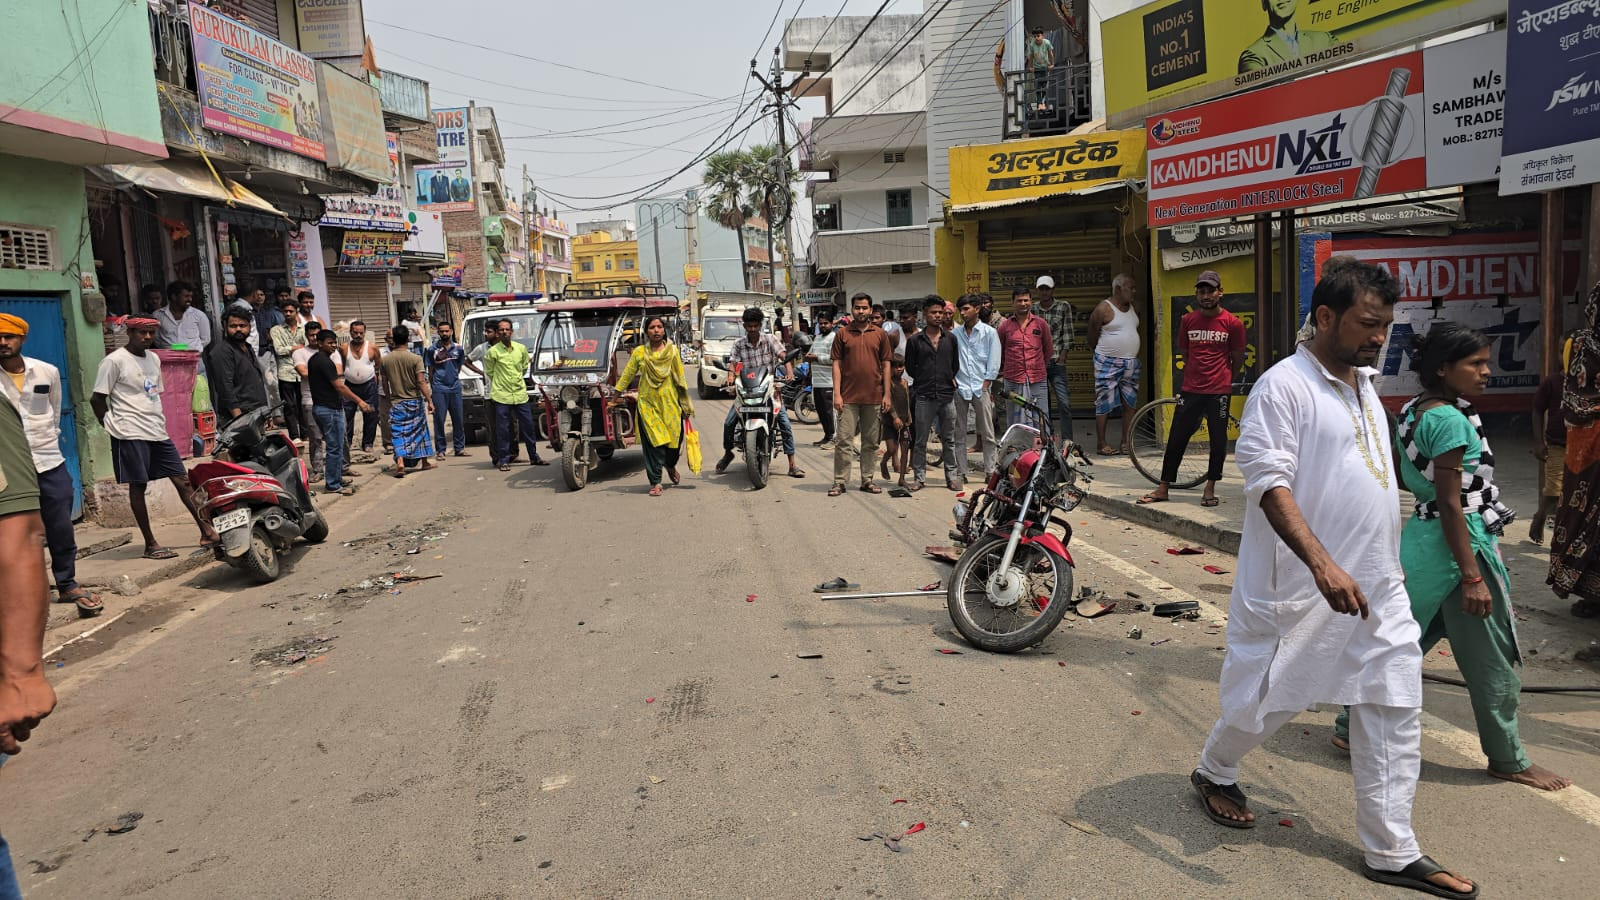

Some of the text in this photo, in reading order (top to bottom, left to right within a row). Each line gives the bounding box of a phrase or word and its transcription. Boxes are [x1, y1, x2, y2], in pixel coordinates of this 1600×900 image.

[1152, 10, 1194, 36] INDIA'S
[1311, 0, 1380, 25] The Engin
[192, 6, 315, 83] GURUKULAM CLASSES
[227, 62, 243, 77] FOR
[242, 67, 264, 85] CLASS
[1151, 50, 1201, 77] CEMENT
[1234, 42, 1355, 87] SAMBHAWANA TRADERS
[1473, 69, 1502, 90] M/s
[1544, 80, 1593, 112] JSW
[1177, 126, 1200, 137] STEEL
[1455, 109, 1503, 128] TRADE
[1153, 112, 1348, 185] KAMDHENU Nxt
[1521, 171, 1554, 187] संभावना
[1155, 178, 1344, 219] Next Generation INTERLOCK Steel
[1207, 225, 1226, 238] M/S
[1312, 212, 1367, 226] TRADERS
[216, 515, 246, 531] 7212
